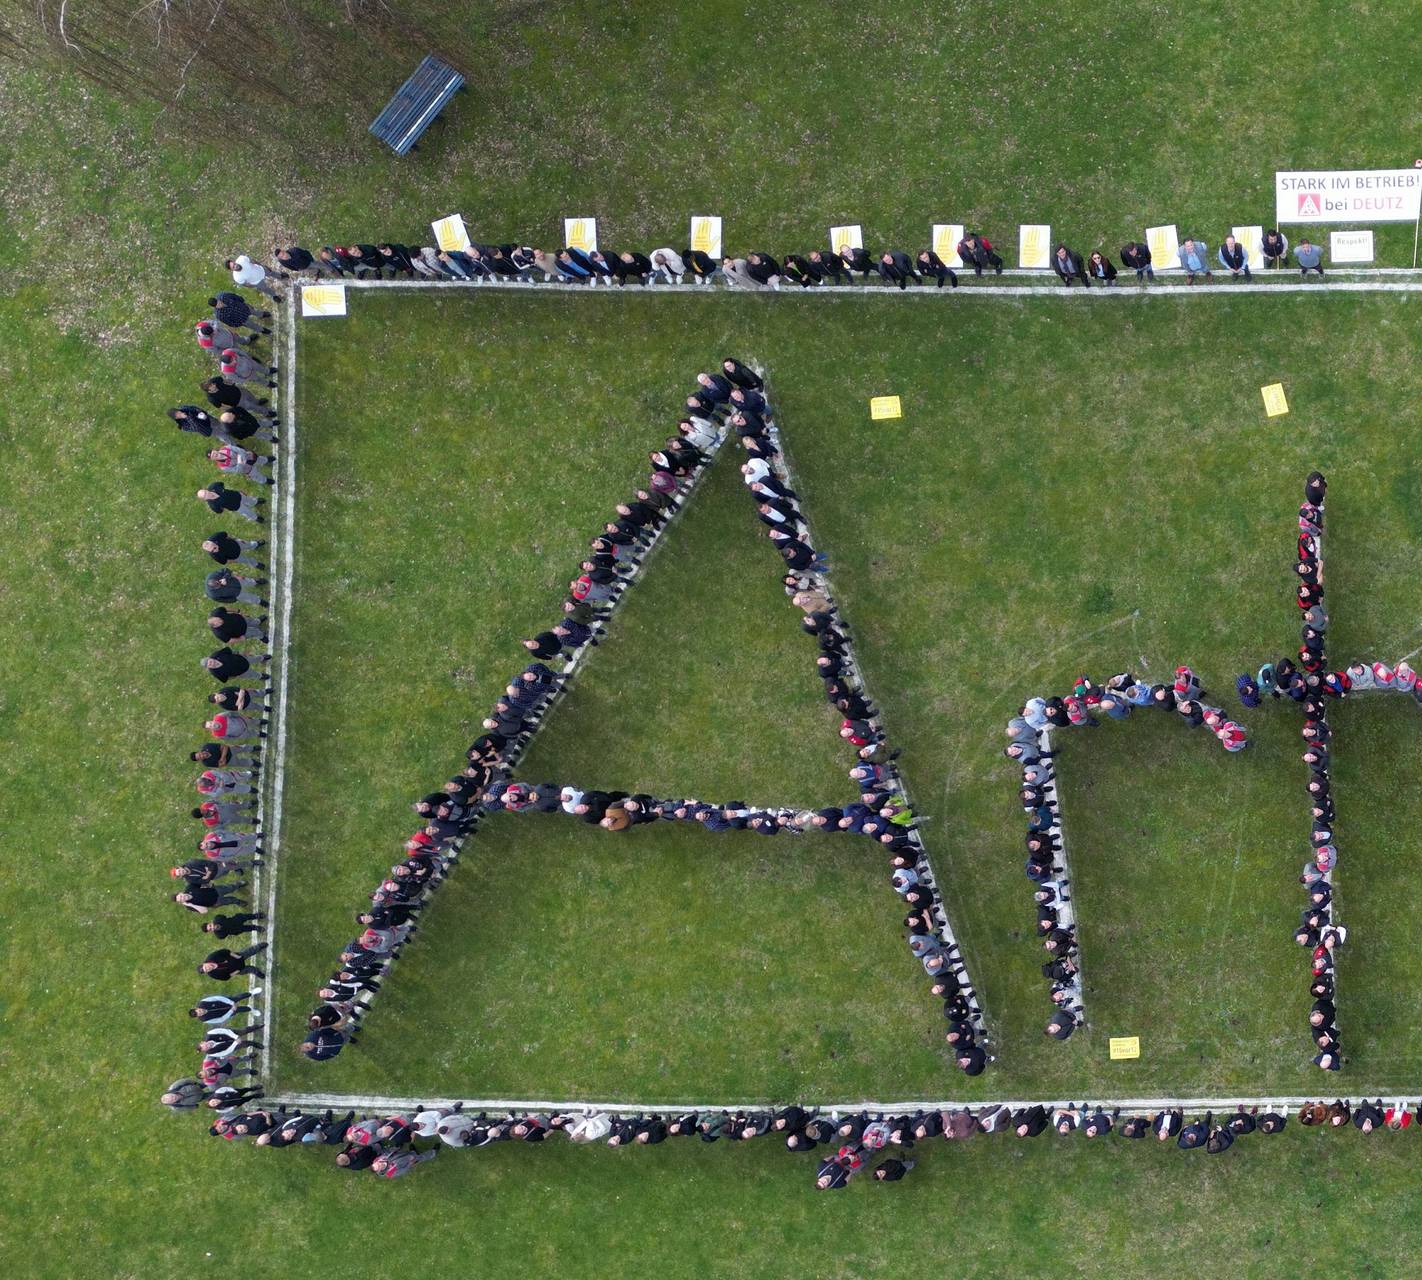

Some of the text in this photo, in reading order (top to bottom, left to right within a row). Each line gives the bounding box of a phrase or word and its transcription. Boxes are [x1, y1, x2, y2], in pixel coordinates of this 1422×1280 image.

[1281, 174, 1420, 191] STARK IM BETRIEB!
[1325, 196, 1403, 211] bei DEUTZ
